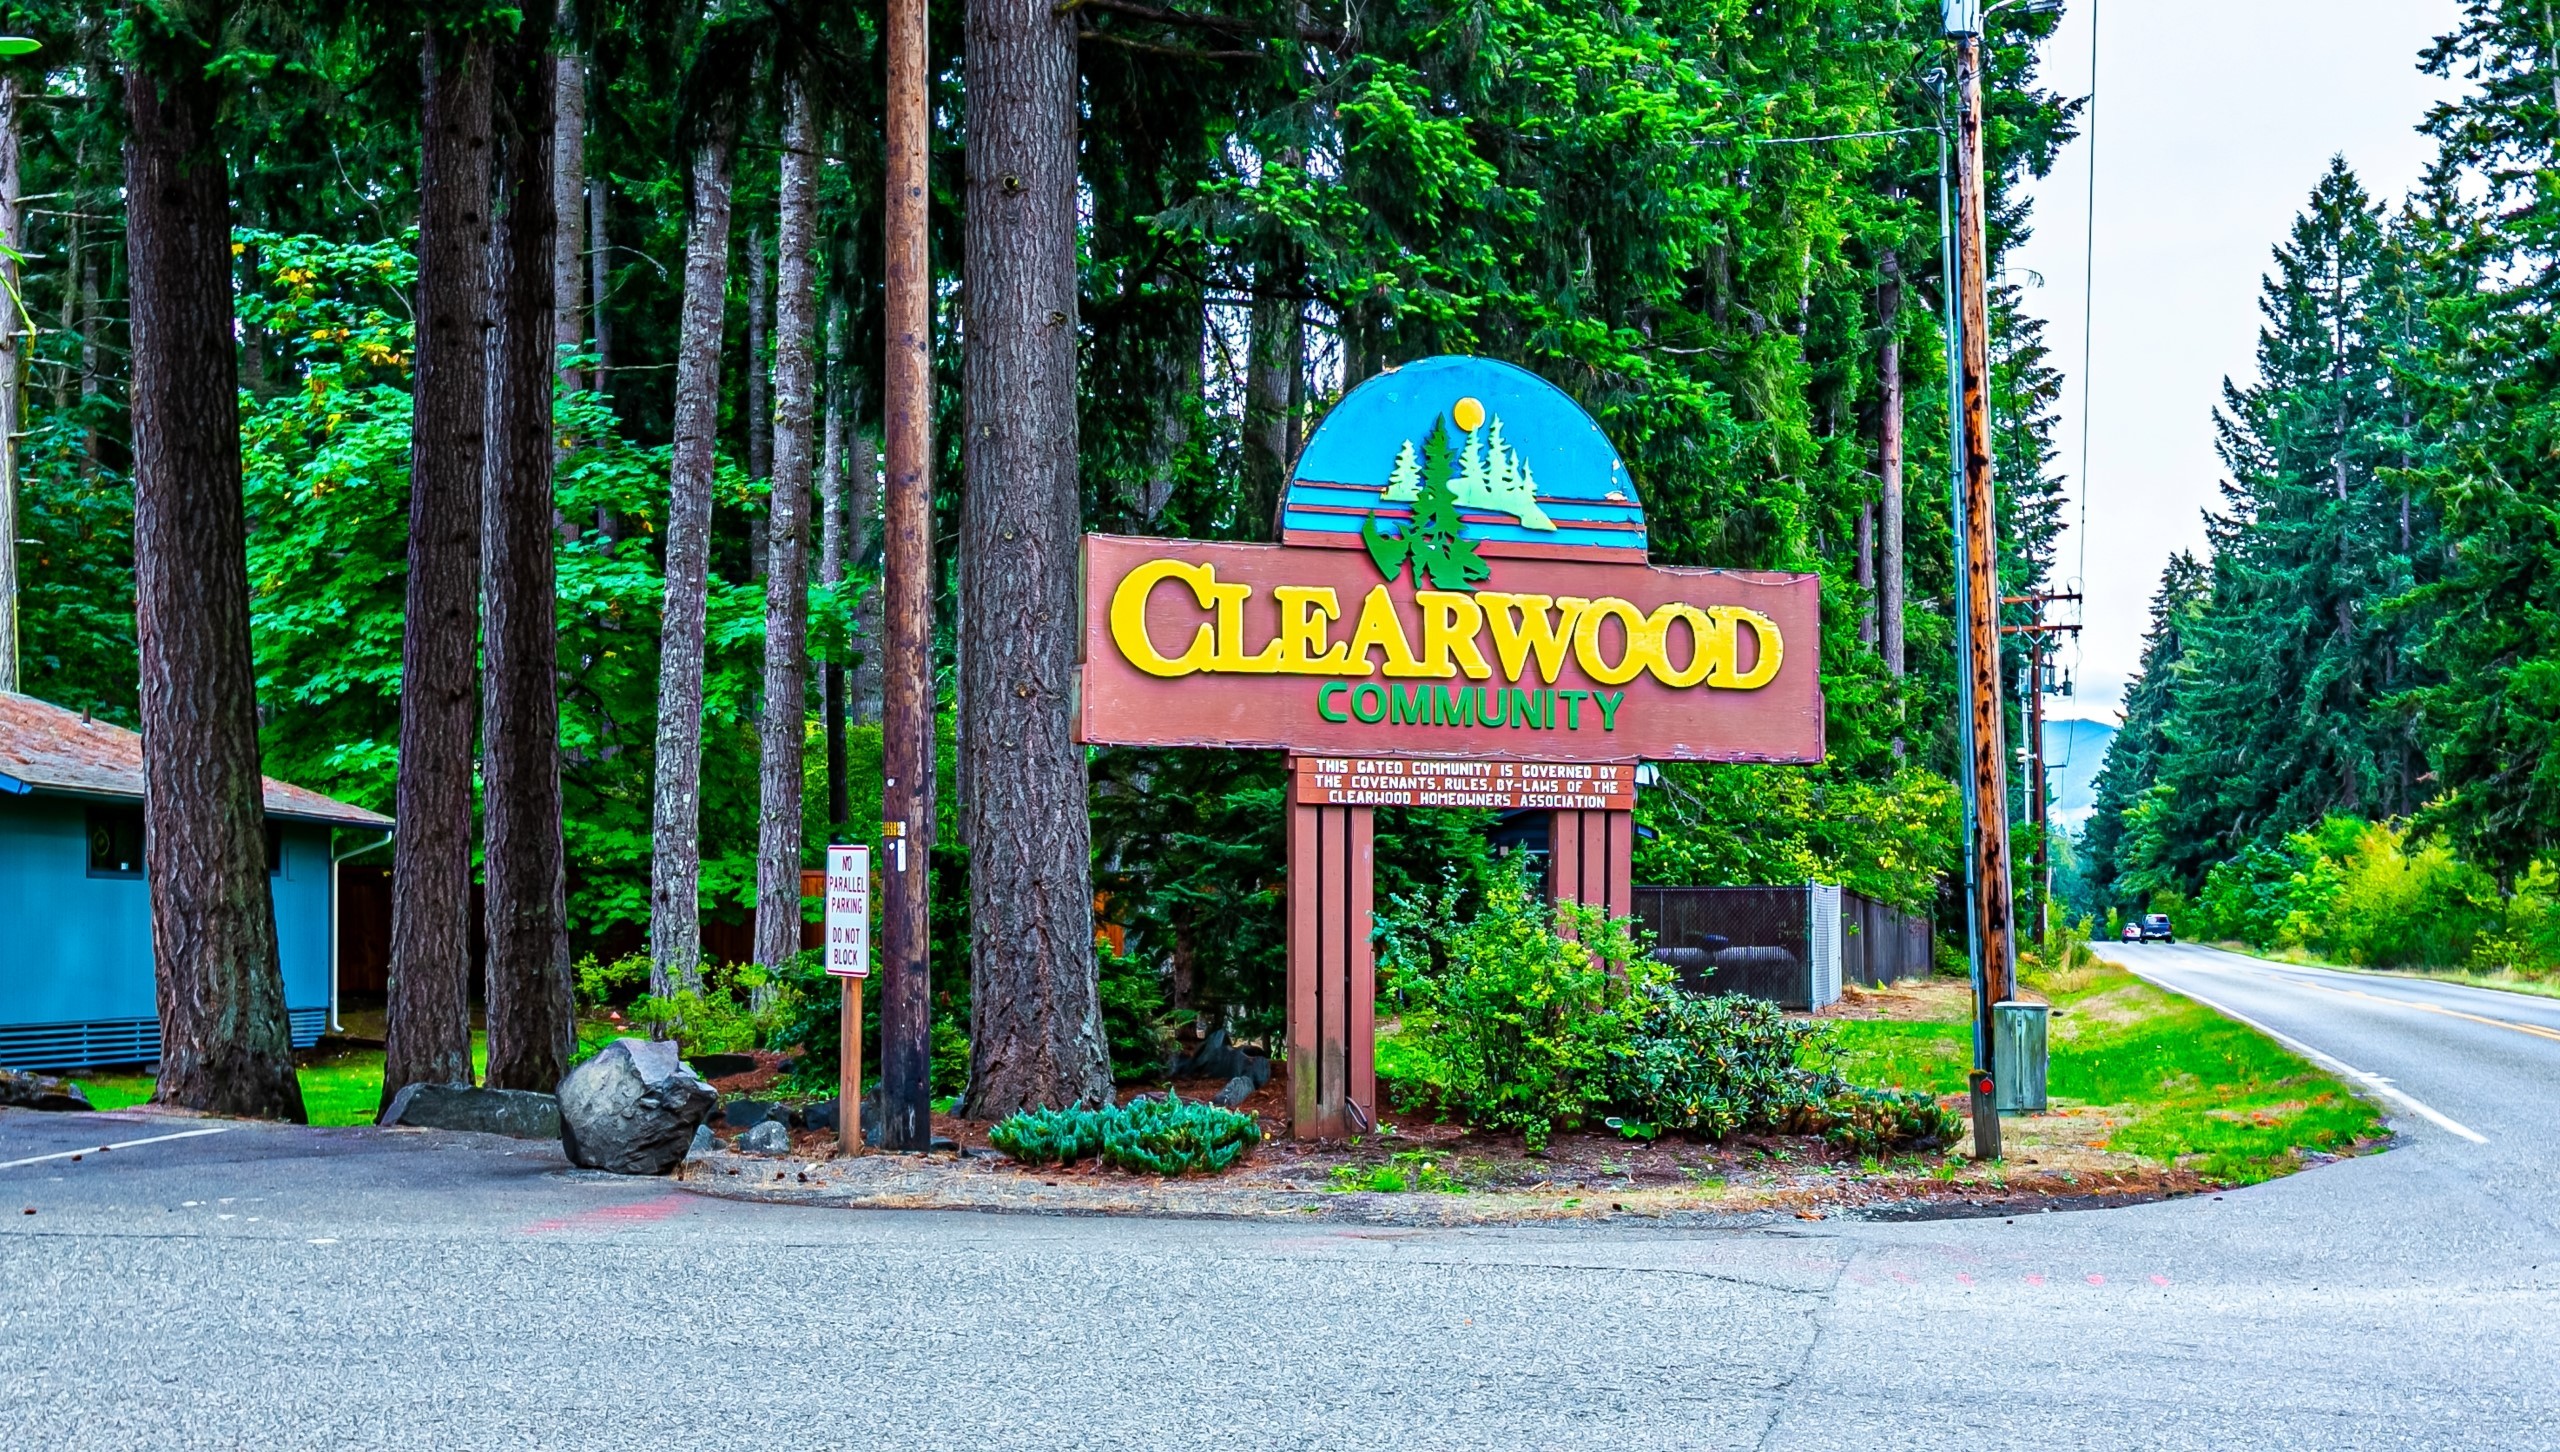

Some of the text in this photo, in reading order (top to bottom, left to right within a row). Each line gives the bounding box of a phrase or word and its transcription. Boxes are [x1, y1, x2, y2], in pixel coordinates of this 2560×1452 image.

[1110, 559, 1784, 690] CLEARWOOD
[1317, 680, 1625, 730] COMMUNITY
[1316, 760, 1618, 779] THIS GATED COMMUNITY IS GOVERNED BY
[1315, 775, 1618, 794] THE COVENANTS, RULES, BY-LAWS OF THE
[1329, 790, 1606, 808] CLEARWOOD HOMEOWNERS ASSOCIATION
[842, 856, 853, 871] NO
[830, 876, 865, 893] PARALLEL
[832, 897, 862, 914] PARKING
[832, 927, 860, 944] DO NOT
[834, 949, 858, 966] BLOCK
